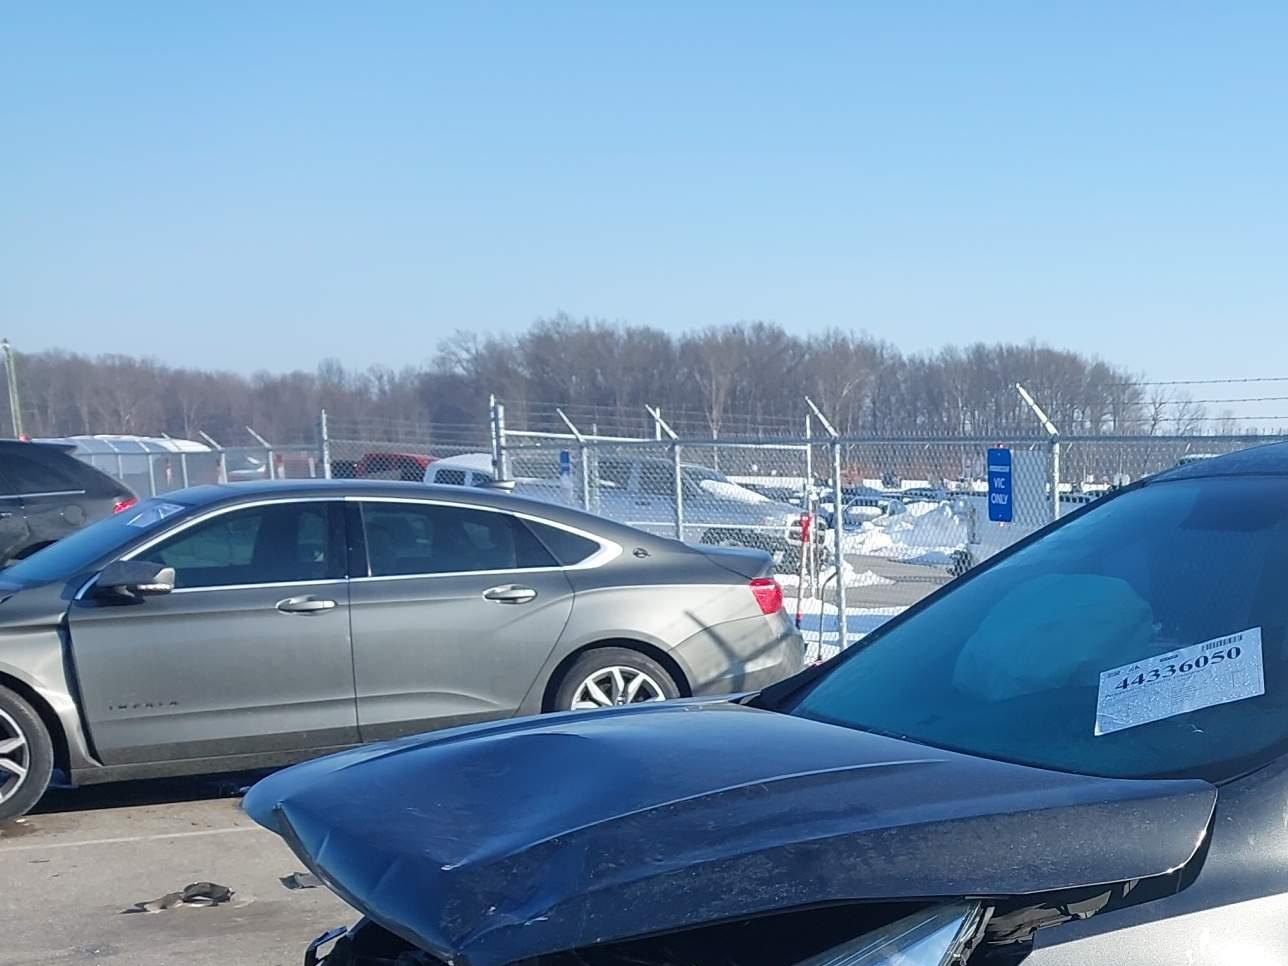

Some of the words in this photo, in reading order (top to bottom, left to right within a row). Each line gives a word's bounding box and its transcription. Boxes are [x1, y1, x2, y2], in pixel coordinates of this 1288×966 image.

[993, 477, 1006, 489] VIC
[991, 493, 1008, 504] ONLY
[1115, 646, 1241, 690] 44336050
